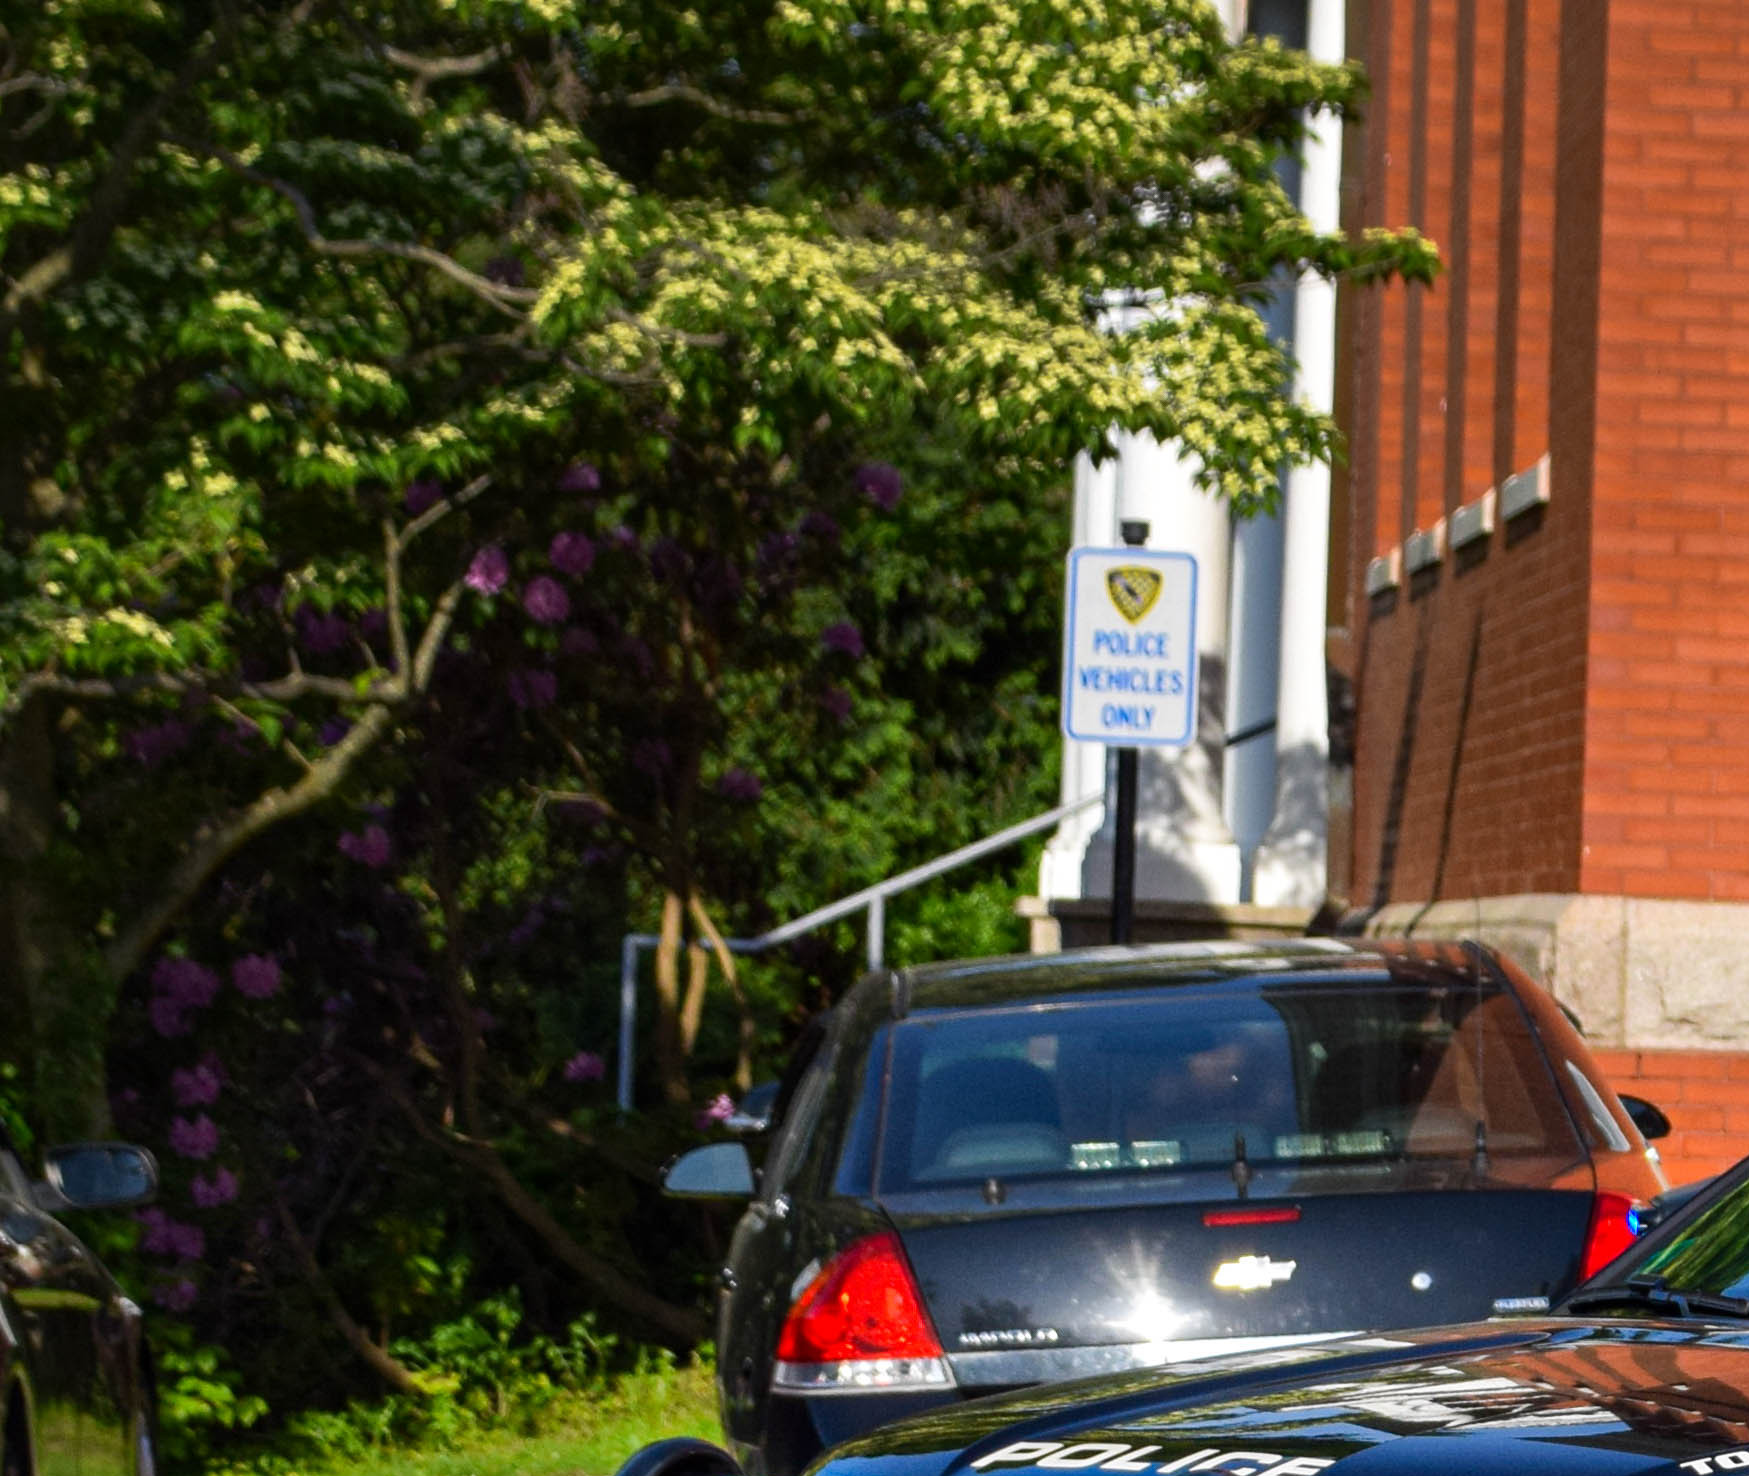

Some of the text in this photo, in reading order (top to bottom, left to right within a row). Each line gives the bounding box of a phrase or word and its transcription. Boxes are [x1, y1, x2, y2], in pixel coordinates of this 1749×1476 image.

[1093, 629, 1169, 657] POLICE
[1079, 666, 1183, 694] VEHICLES
[1102, 704, 1155, 728] ONLY
